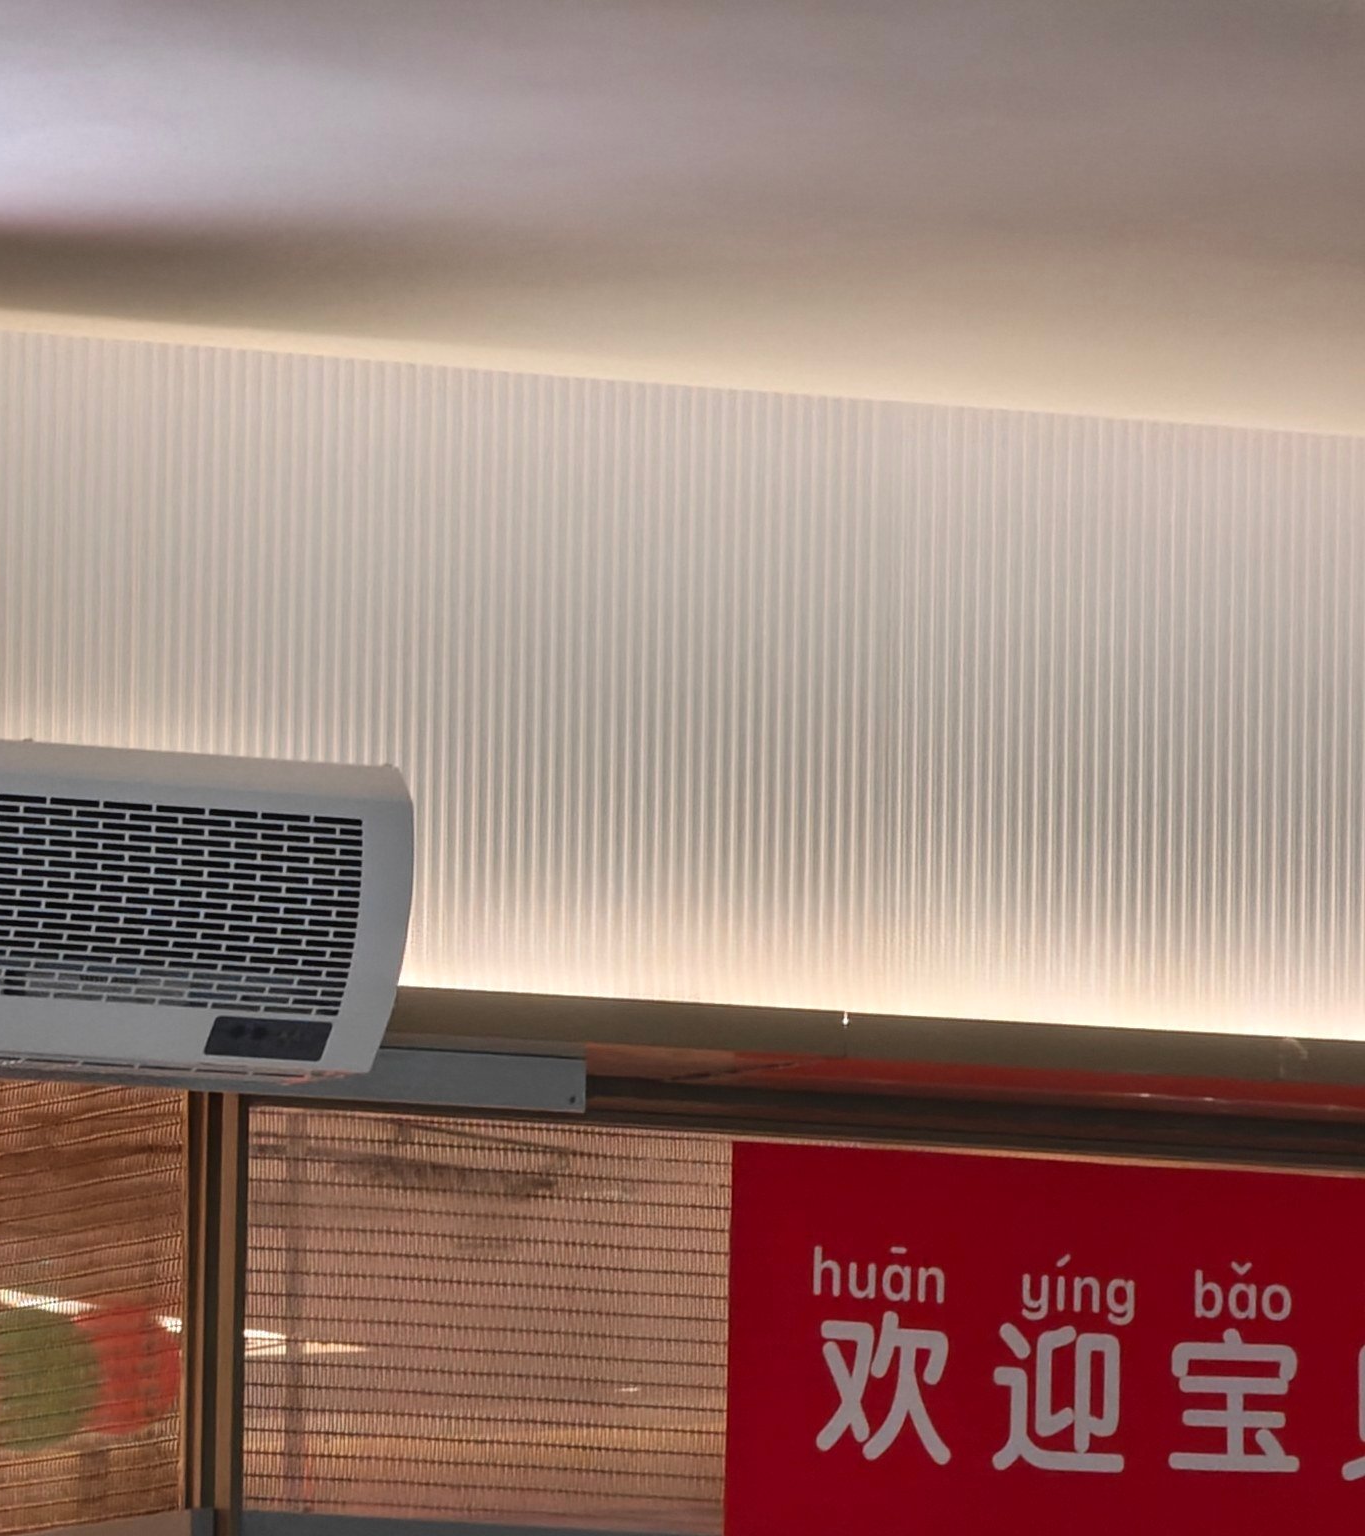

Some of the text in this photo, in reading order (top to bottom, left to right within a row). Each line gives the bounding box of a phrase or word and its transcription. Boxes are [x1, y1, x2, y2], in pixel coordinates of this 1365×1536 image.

[813, 1246, 1293, 1326] huān yíng bǎo
[815, 1309, 1365, 1482] 欢迎宝
